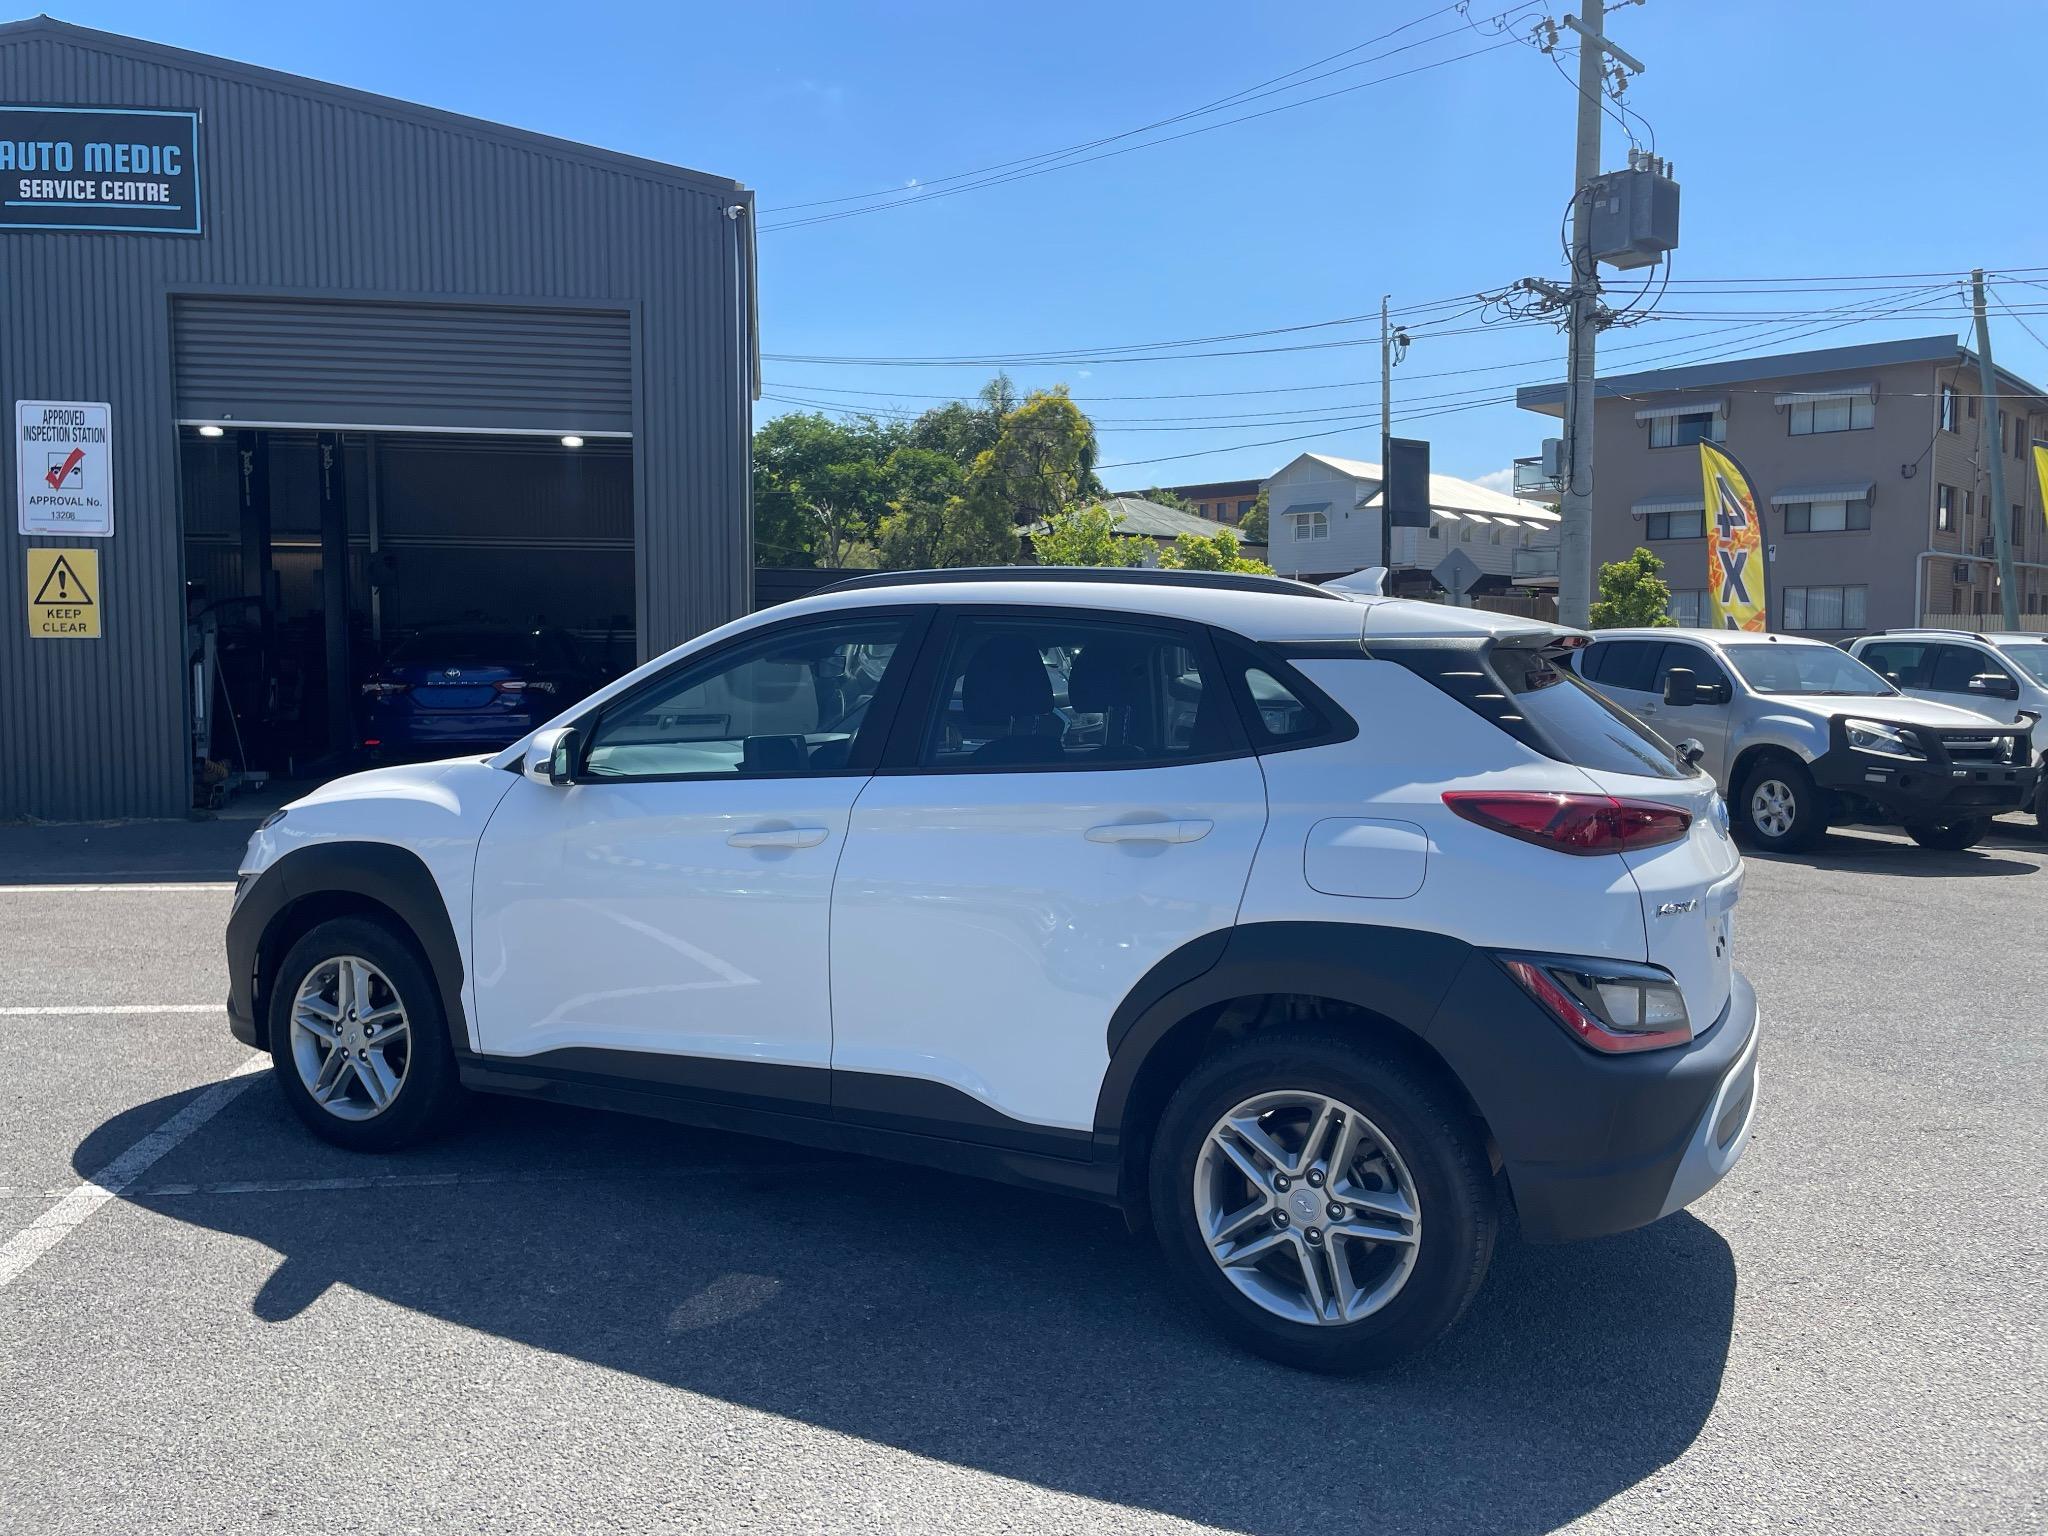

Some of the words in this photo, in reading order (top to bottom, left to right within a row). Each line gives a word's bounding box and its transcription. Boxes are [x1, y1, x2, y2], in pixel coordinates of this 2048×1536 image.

[0, 140, 73, 171] AUTO
[84, 143, 182, 176] MEDIC
[19, 179, 96, 200] SERVICE
[101, 180, 170, 202] CENTRE
[42, 409, 85, 426] APPROVED
[23, 425, 70, 443] INSPECTION
[72, 427, 106, 443] STATION
[29, 496, 84, 506] APPROVAL
[86, 497, 103, 507] No.
[1715, 475, 1750, 631] 4X
[47, 608, 82, 619] KEEP
[42, 622, 87, 633] CLEAR
